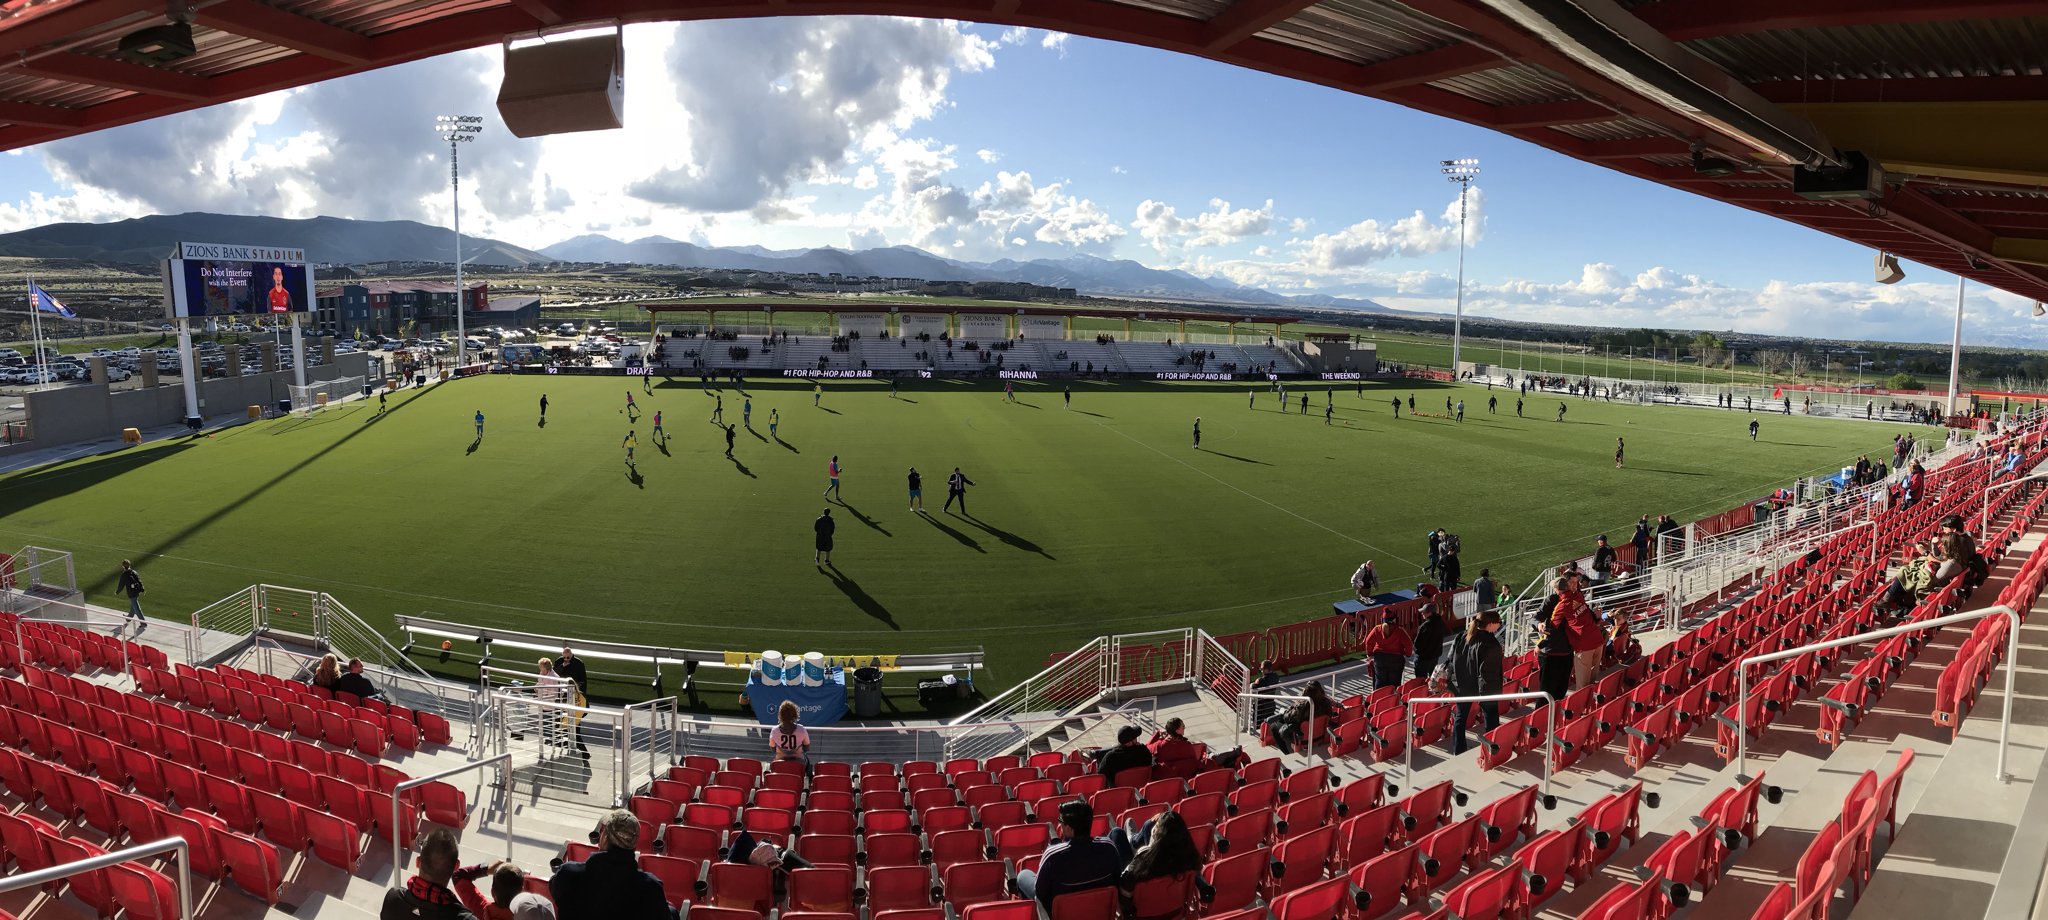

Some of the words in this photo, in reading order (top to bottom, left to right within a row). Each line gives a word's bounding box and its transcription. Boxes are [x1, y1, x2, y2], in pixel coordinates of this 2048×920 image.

[186, 245, 219, 258] ZIONS
[223, 247, 250, 259] BANK
[252, 249, 303, 260] STADIUM
[201, 268, 212, 277] Do
[213, 268, 225, 277] Not
[226, 268, 253, 277] Interfere
[229, 278, 247, 286] Event
[626, 367, 654, 375] DRAKE
[792, 369, 808, 377] FOR
[839, 370, 856, 378] AND
[856, 370, 872, 378] R&B
[999, 370, 1038, 379] RIHANNA
[1321, 372, 1334, 380] THE
[1333, 372, 1361, 380] WEEKND
[780, 734, 797, 750] 20
